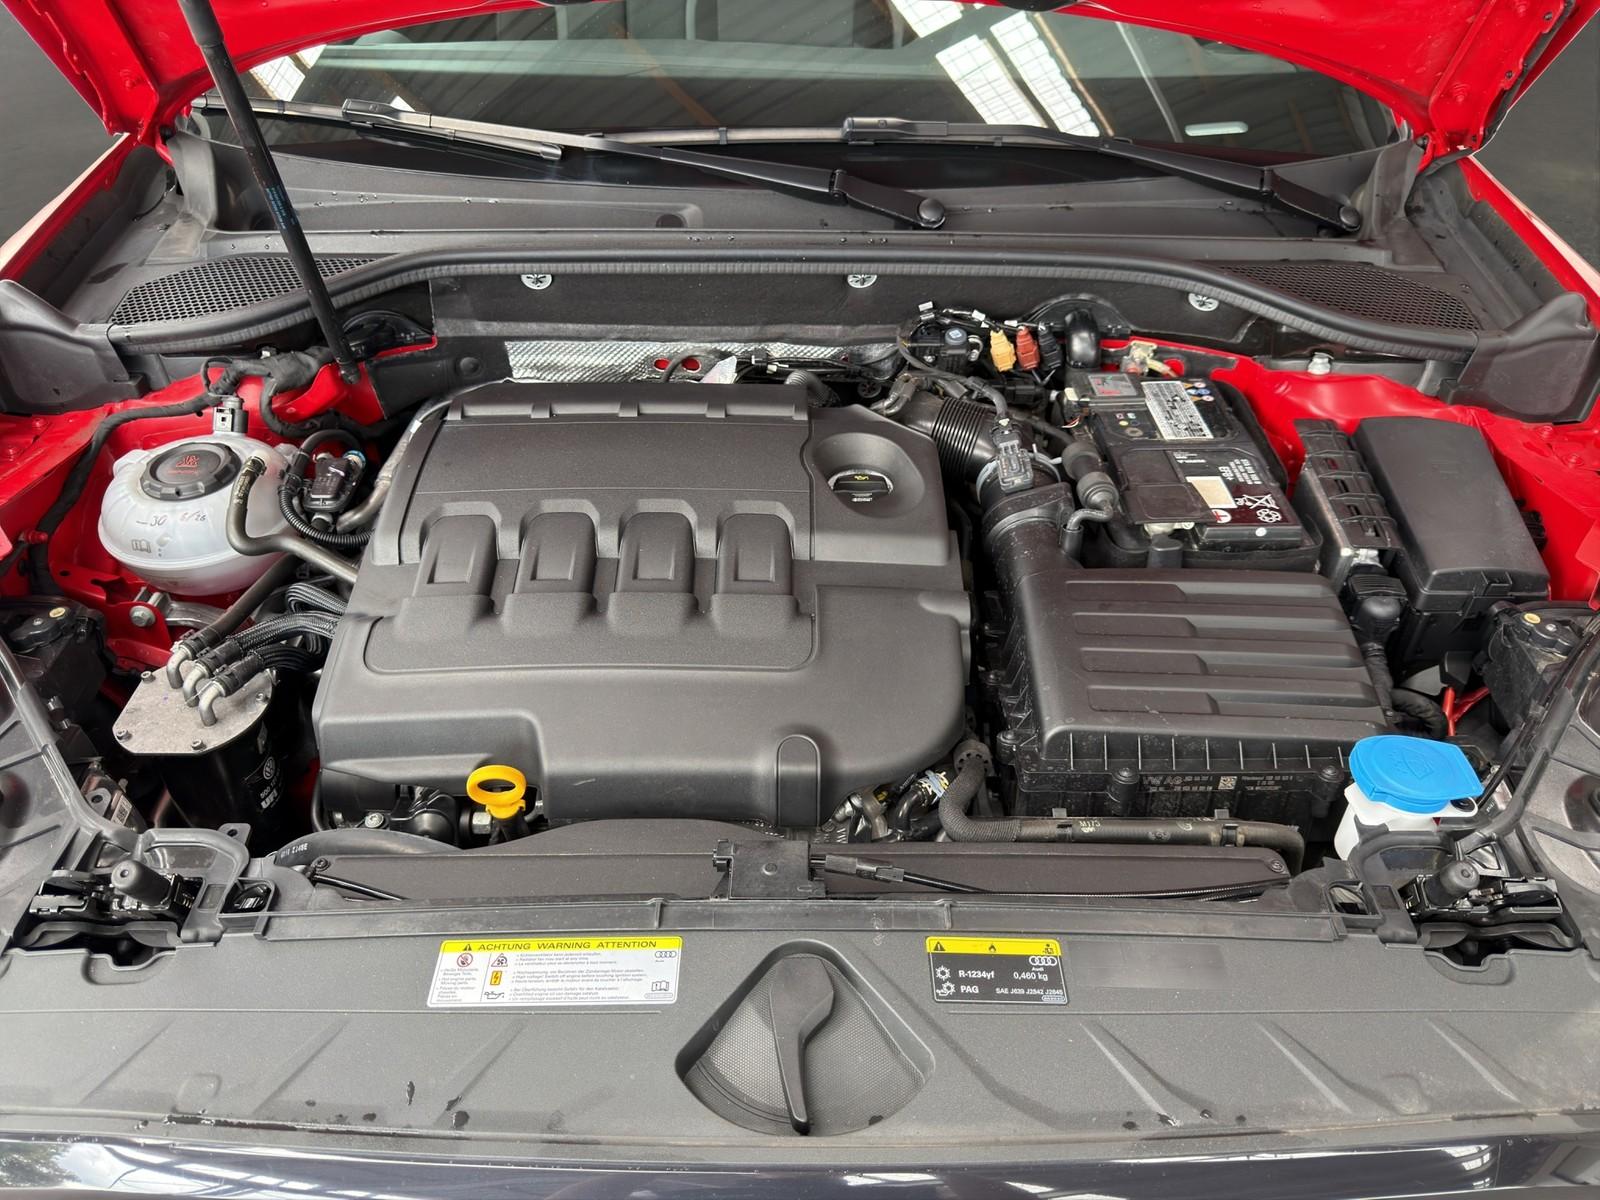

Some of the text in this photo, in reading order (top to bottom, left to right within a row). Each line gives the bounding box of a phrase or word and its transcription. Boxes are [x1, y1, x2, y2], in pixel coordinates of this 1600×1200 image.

[478, 940, 657, 951] ACHTUNG WARNING ATTENTION
[958, 970, 1049, 981] R-1234yf 0,460 kg
[960, 985, 979, 994] PAG
